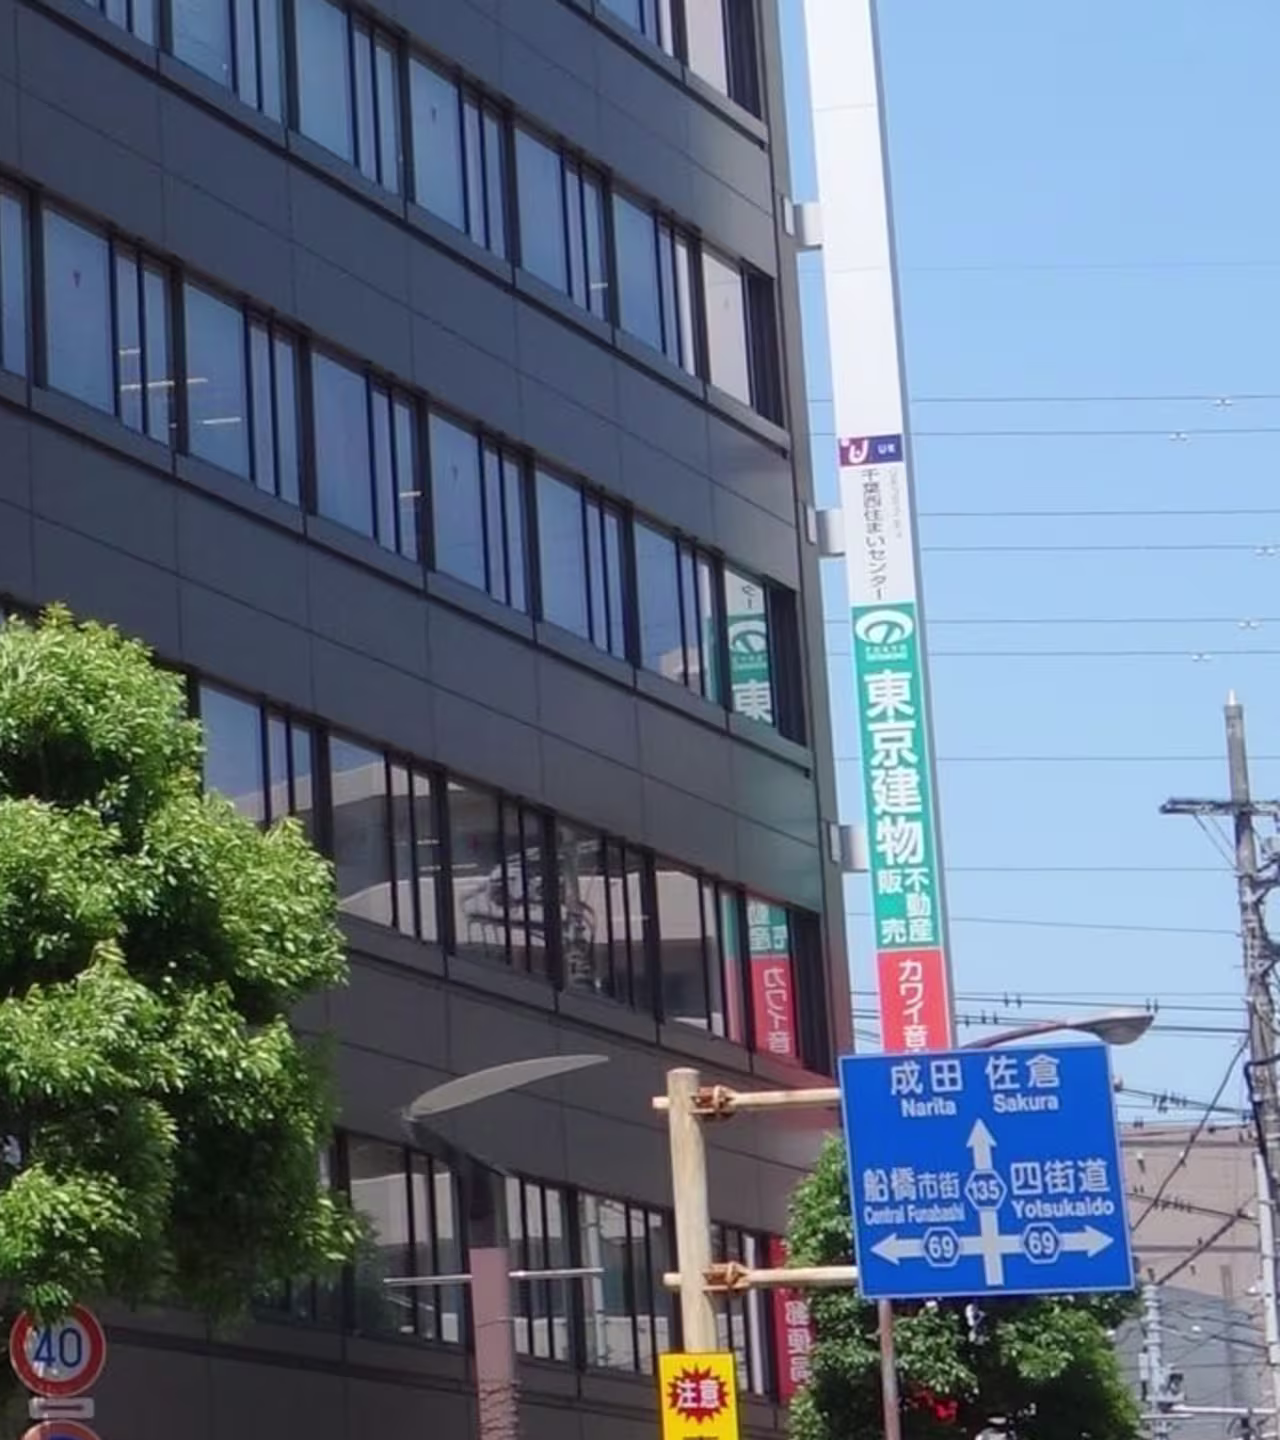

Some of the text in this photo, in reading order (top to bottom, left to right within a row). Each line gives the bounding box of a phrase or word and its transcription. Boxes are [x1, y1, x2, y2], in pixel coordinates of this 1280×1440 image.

[862, 670, 924, 867] 東京建物
[905, 867, 934, 944] 不動産
[897, 958, 929, 1053] カワイ音
[890, 1053, 1061, 1097] 成田 佐倉
[900, 1092, 1059, 1118] Narita Sakura
[862, 1158, 1112, 1203] 船橋市街 四街道
[970, 1178, 1002, 1201] 135
[863, 1196, 1115, 1226] Central Funabashi Yotsukaido
[928, 1233, 955, 1259] 69
[1028, 1231, 1055, 1256] 69
[32, 1327, 83, 1368] 40
[674, 1377, 724, 1412] 注意
